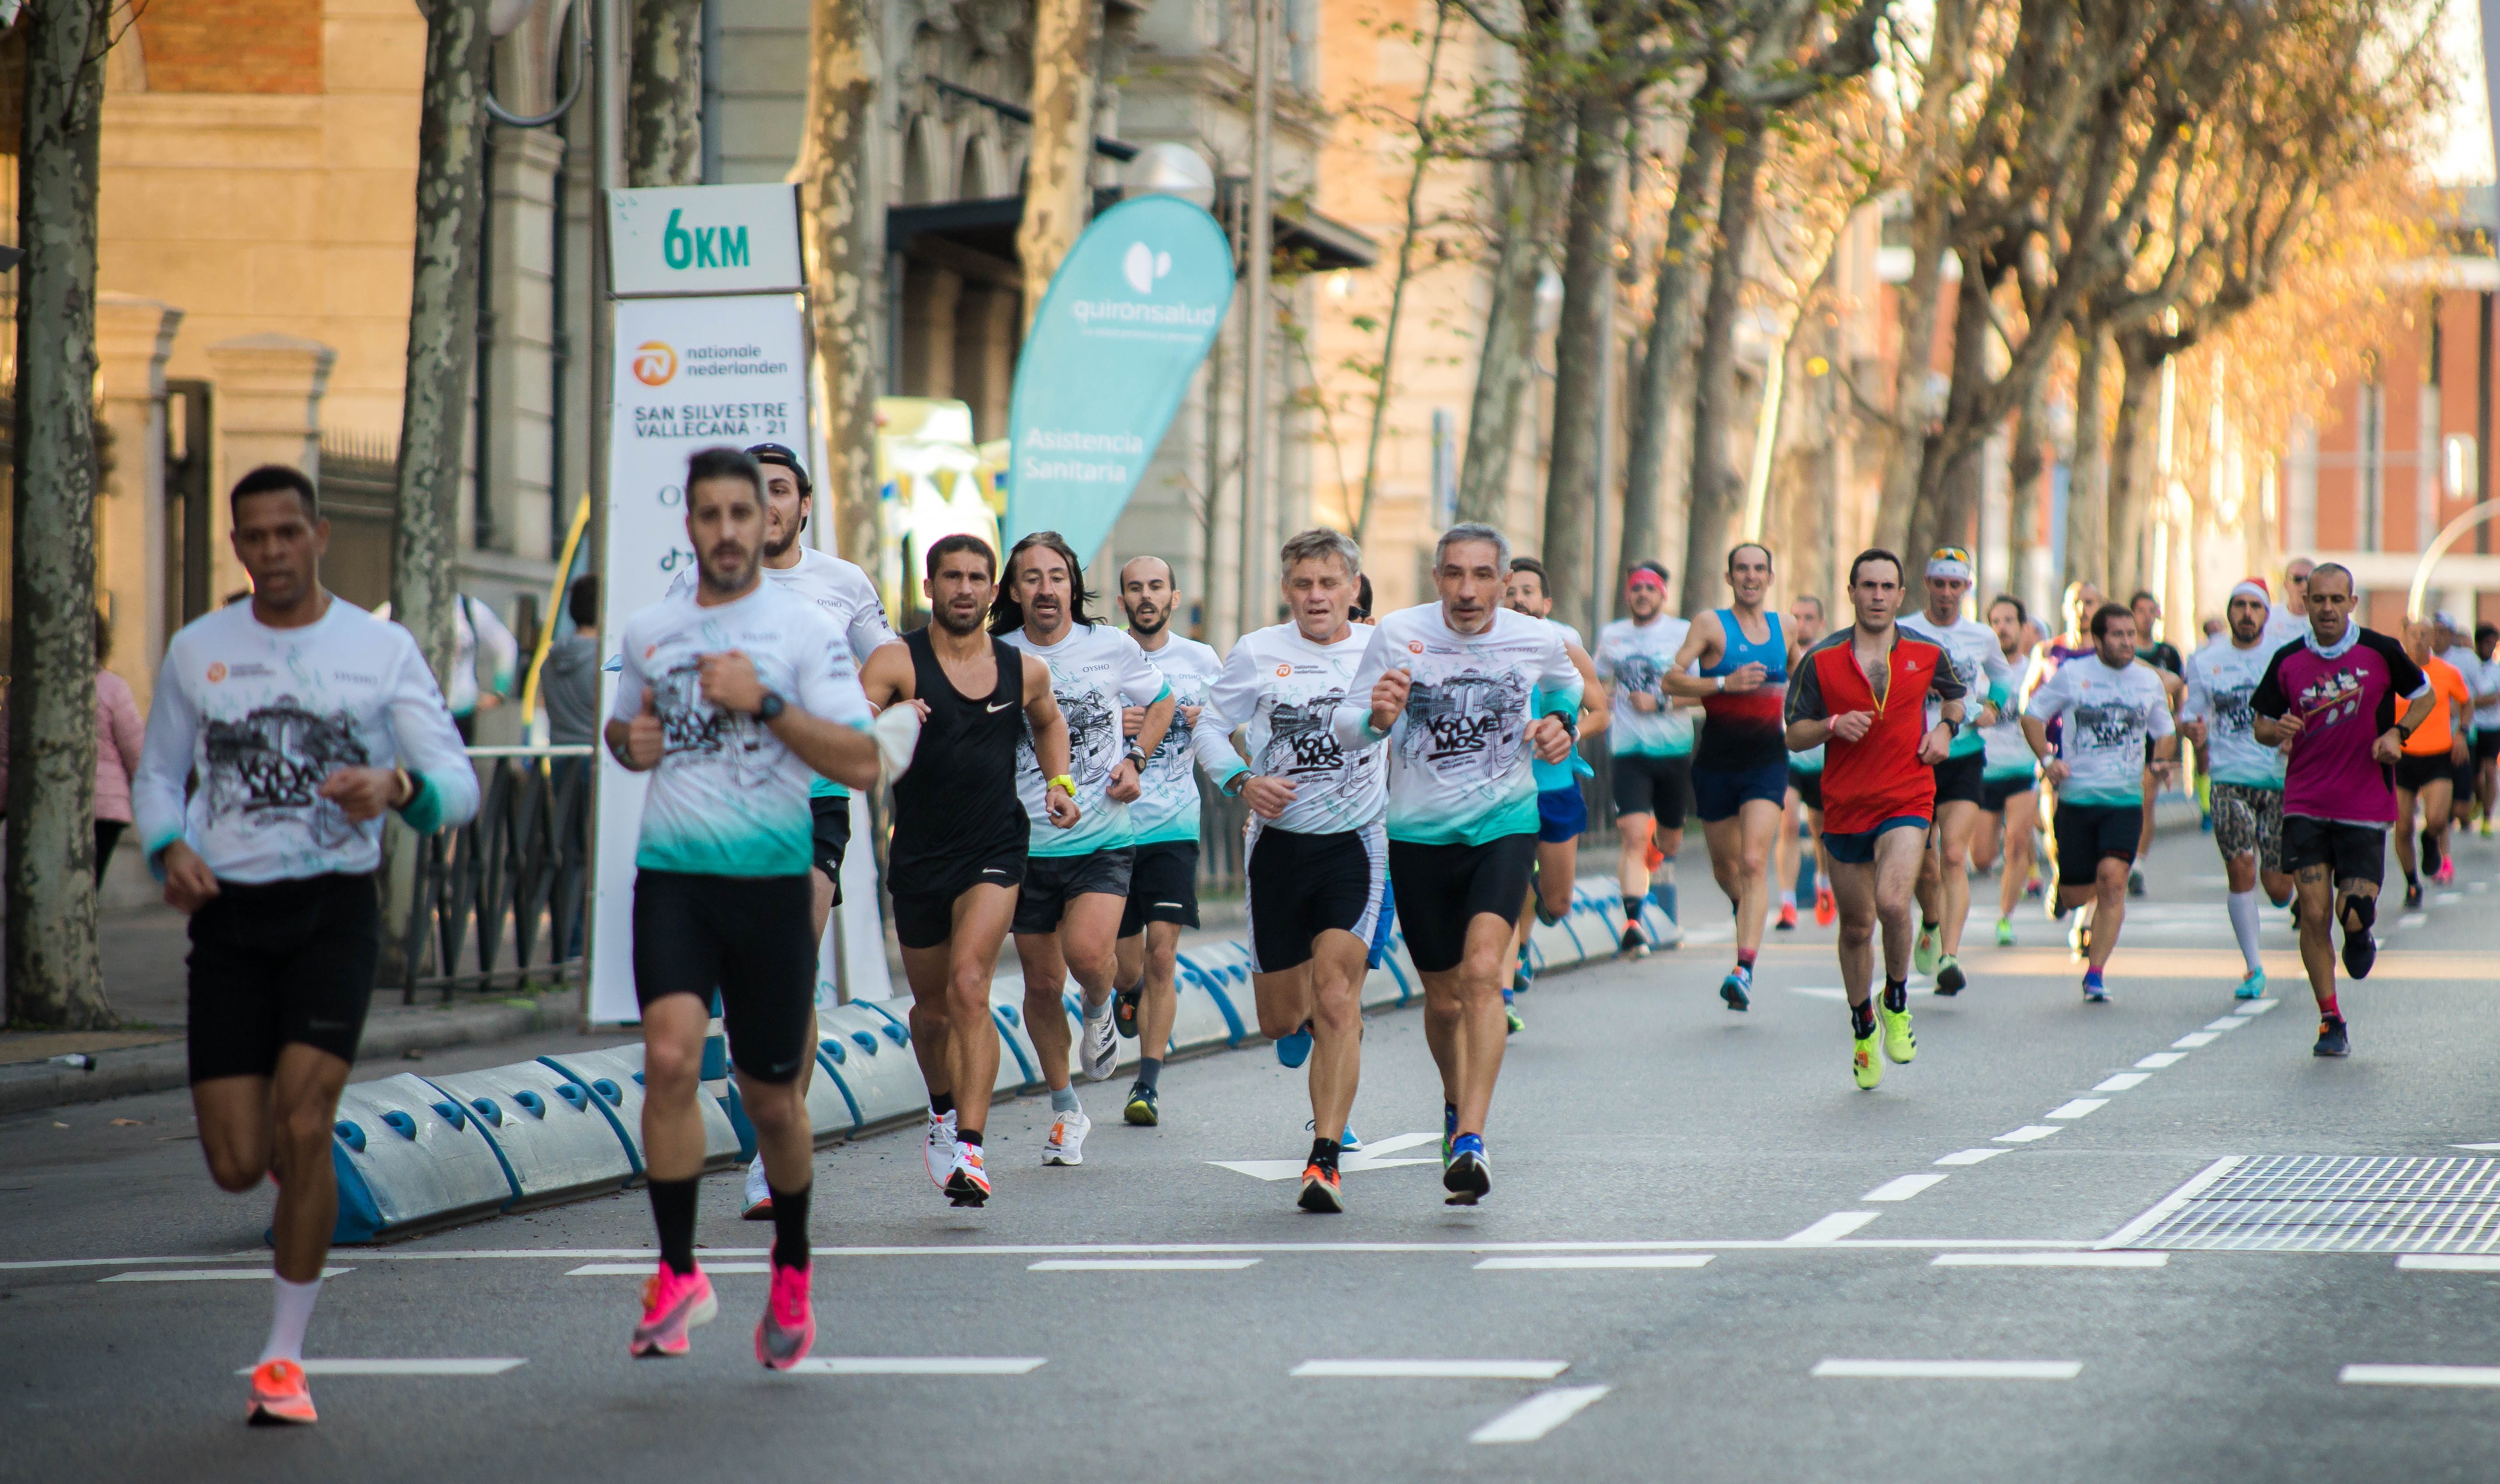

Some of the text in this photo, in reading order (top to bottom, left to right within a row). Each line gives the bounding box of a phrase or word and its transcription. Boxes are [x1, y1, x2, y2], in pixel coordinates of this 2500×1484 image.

[664, 207, 750, 270] 6KM
[687, 344, 762, 359] nationale
[687, 360, 788, 375] nederlanden
[636, 402, 788, 421] SAN SILVESTRE
[636, 420, 787, 438] VALLECANA 21
[1025, 426, 1143, 453] Asistencia
[1025, 456, 1127, 482] Sanitaria
[817, 598, 842, 608] OYSHO
[1083, 663, 1110, 673] OYSHO
[1426, 714, 1500, 735] VOLVE
[1435, 733, 1487, 752] MOS
[1296, 751, 1344, 768] MOS
